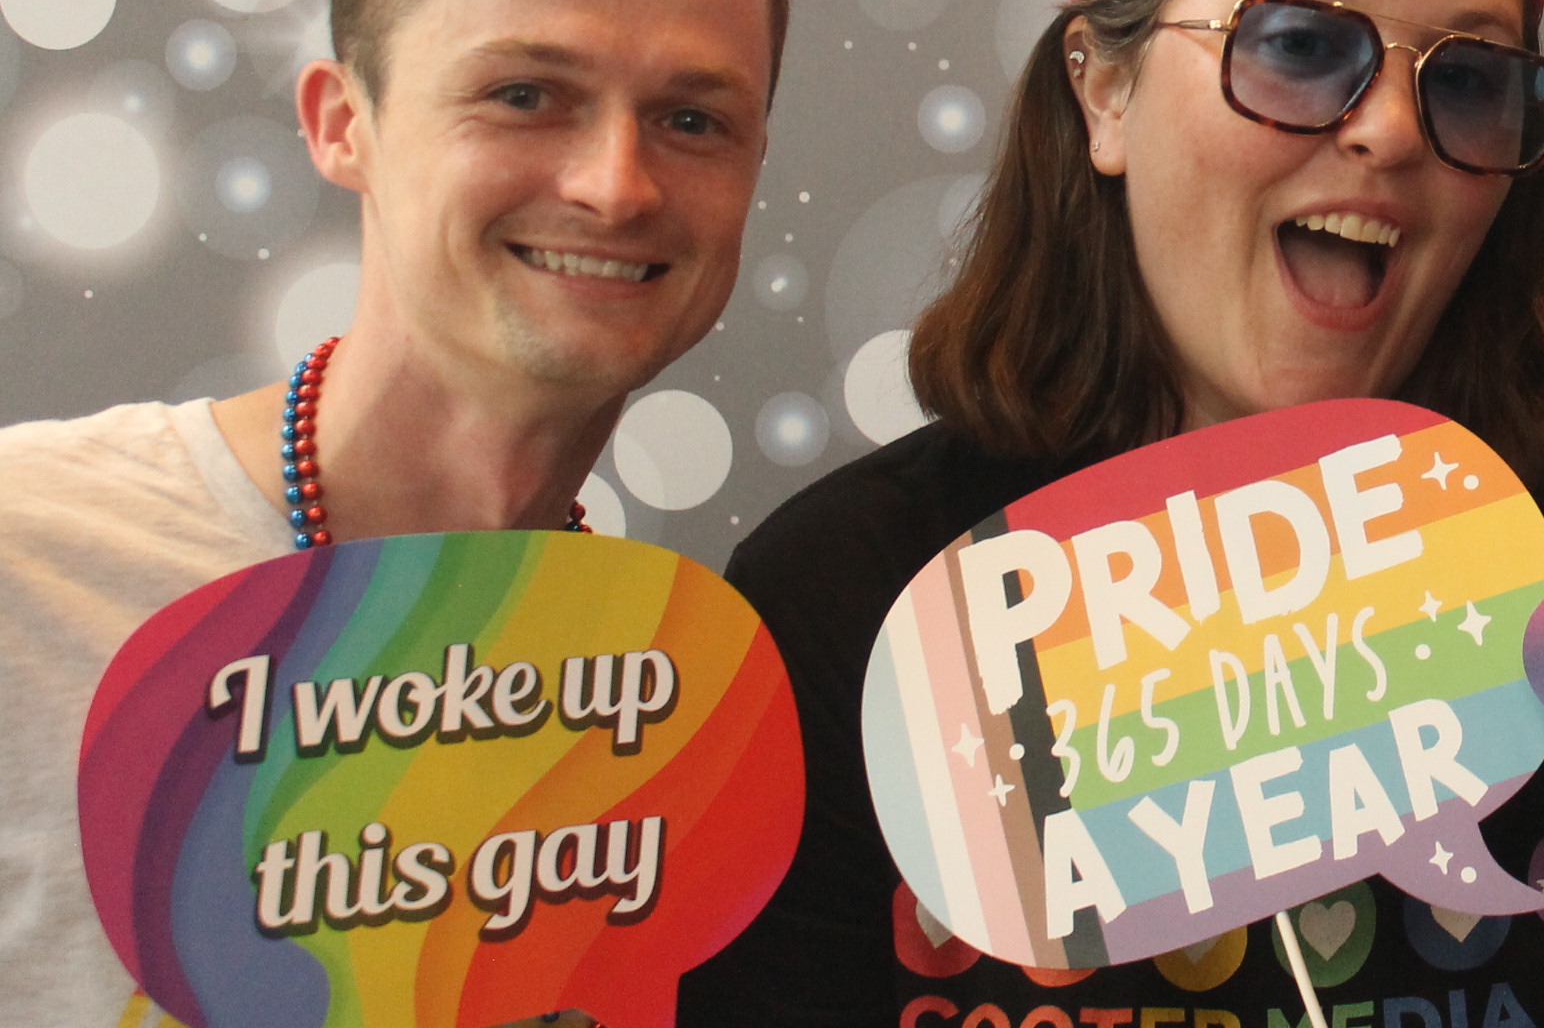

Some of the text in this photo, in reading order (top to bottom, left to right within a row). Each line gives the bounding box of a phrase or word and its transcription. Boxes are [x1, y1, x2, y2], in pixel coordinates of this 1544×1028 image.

[957, 434, 1424, 715] PRIDE
[208, 642, 677, 758] I woke up
[1045, 606, 1388, 798] 365 DAYS
[255, 814, 664, 936] this gay
[1042, 698, 1490, 940] A YEAR
